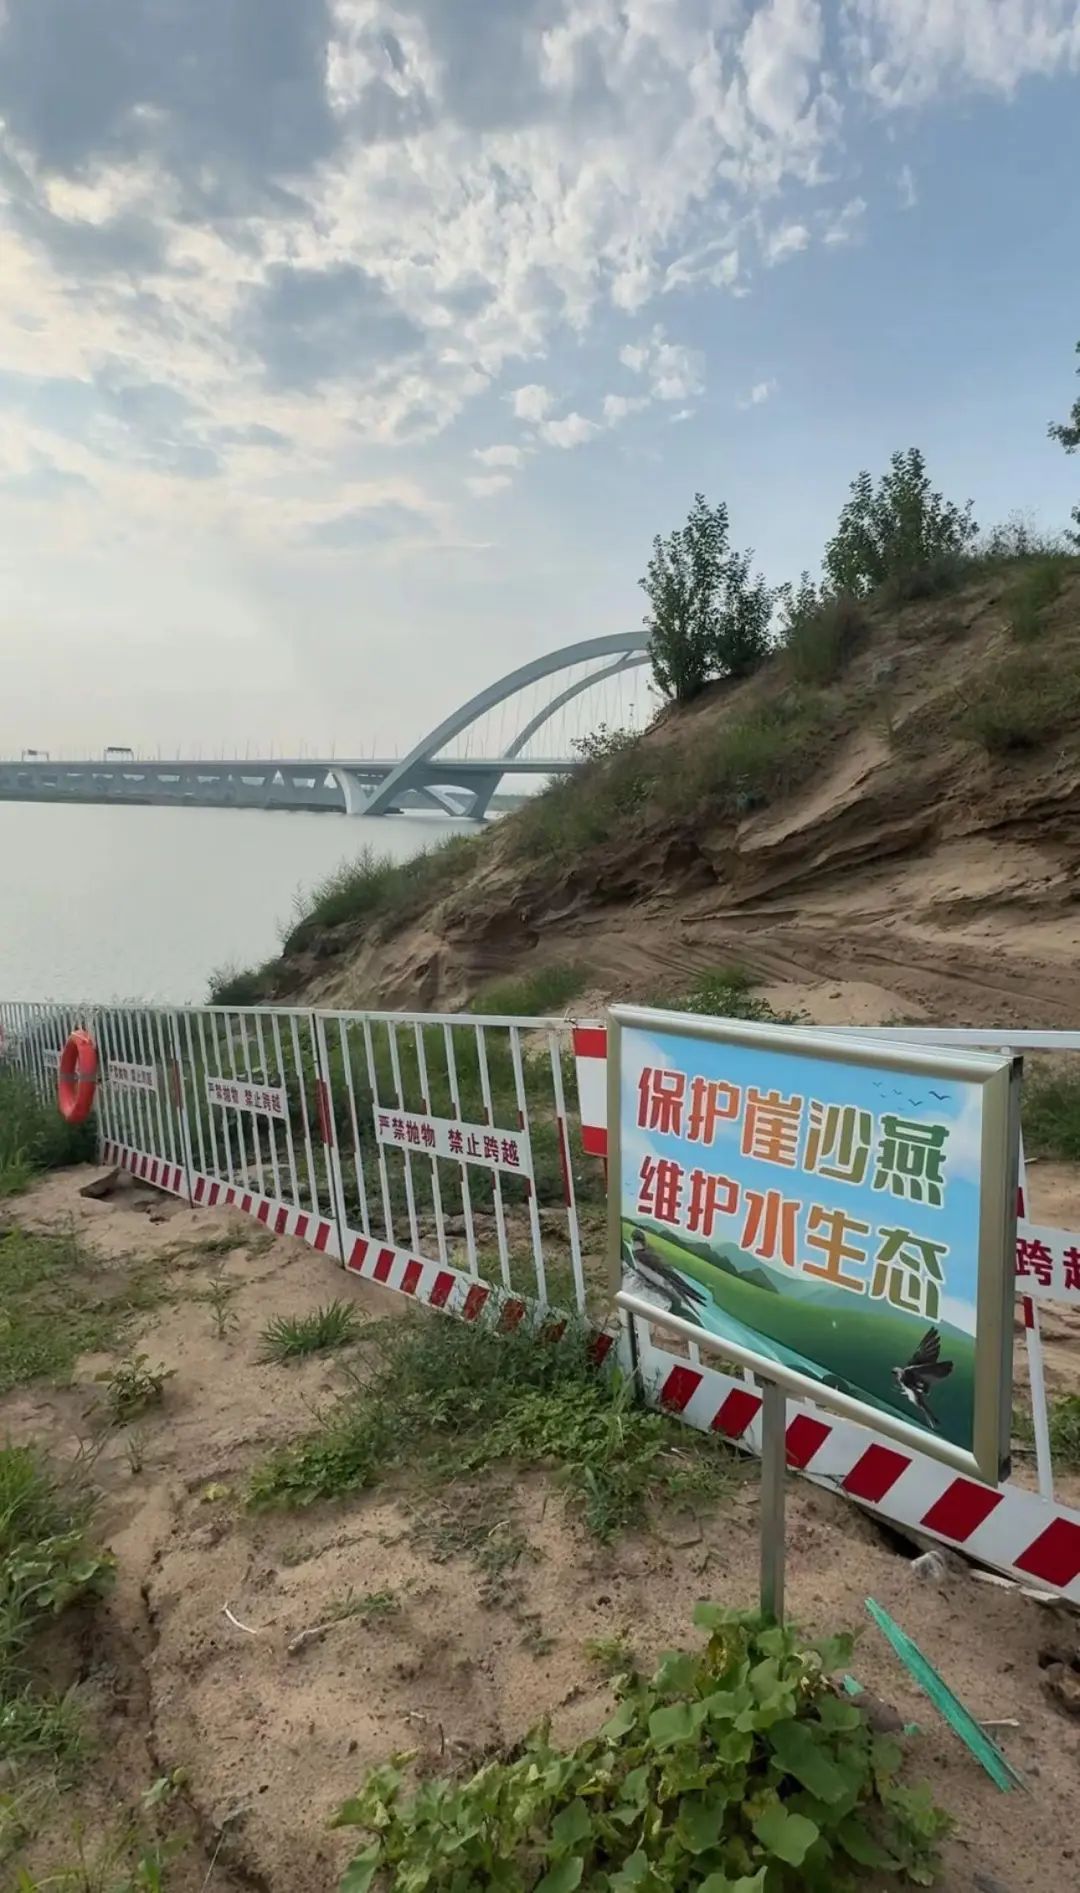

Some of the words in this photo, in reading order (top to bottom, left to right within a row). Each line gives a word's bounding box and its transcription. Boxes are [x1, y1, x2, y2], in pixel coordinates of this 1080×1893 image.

[378, 1115, 436, 1148] 严禁抛物
[448, 1128, 520, 1167] 禁止跨越
[638, 1067, 949, 1206] 保护崖沙燕
[638, 1155, 948, 1320] 维护水生态
